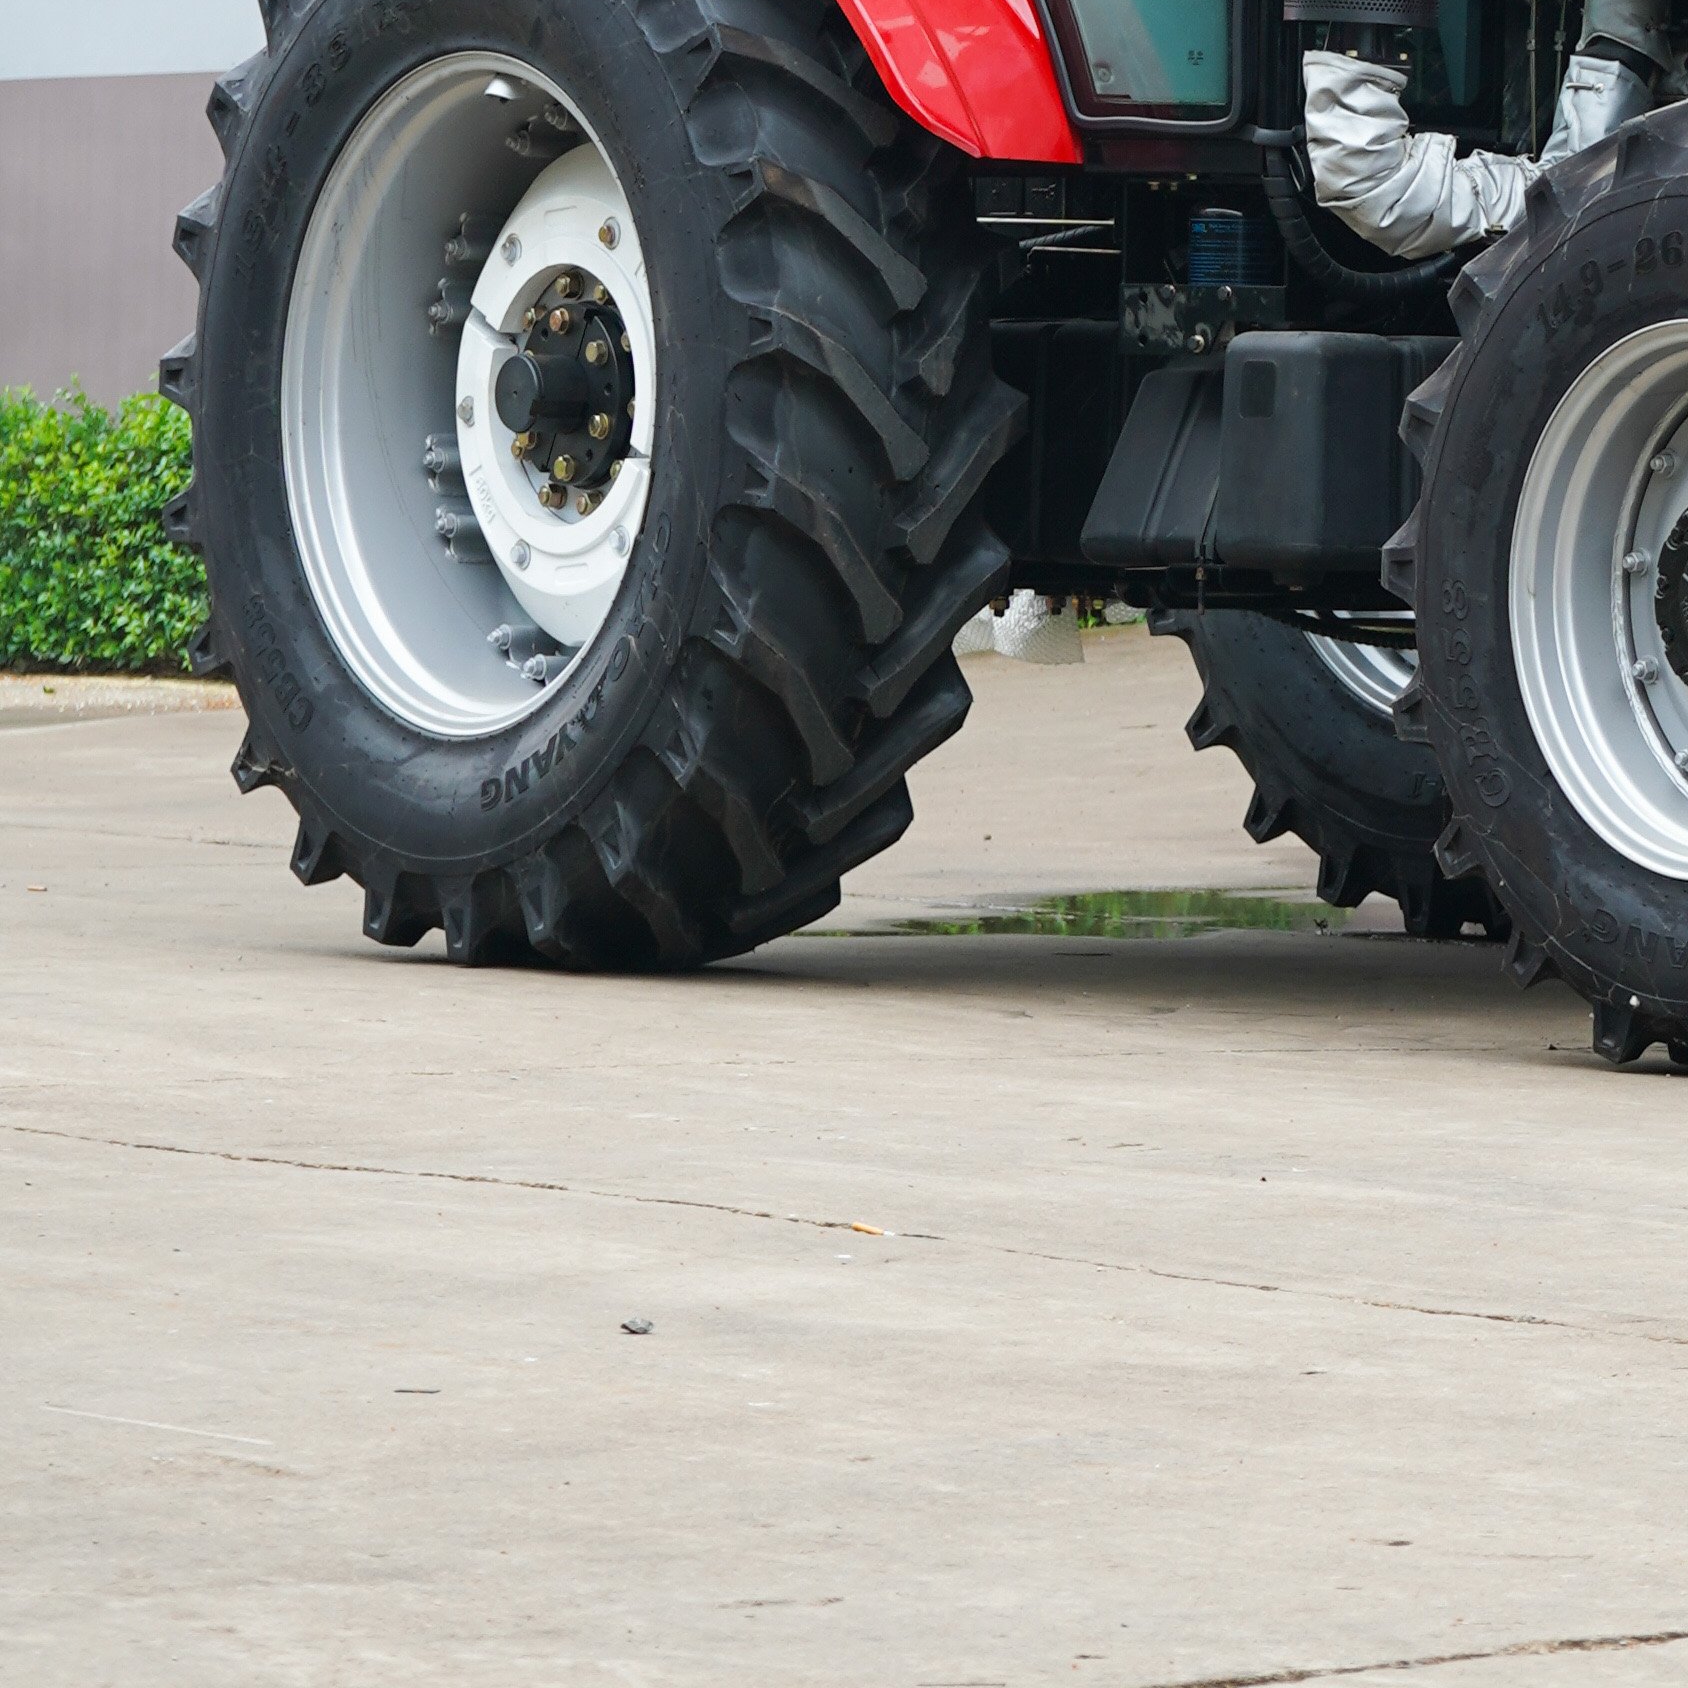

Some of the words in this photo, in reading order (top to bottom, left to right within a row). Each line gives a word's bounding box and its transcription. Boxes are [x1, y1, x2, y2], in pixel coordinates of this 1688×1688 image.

[1537, 230, 1686, 343] 14.9-26
[242, 594, 315, 733] CB558
[1441, 578, 1511, 808] CB558
[480, 723, 577, 812] YANG
